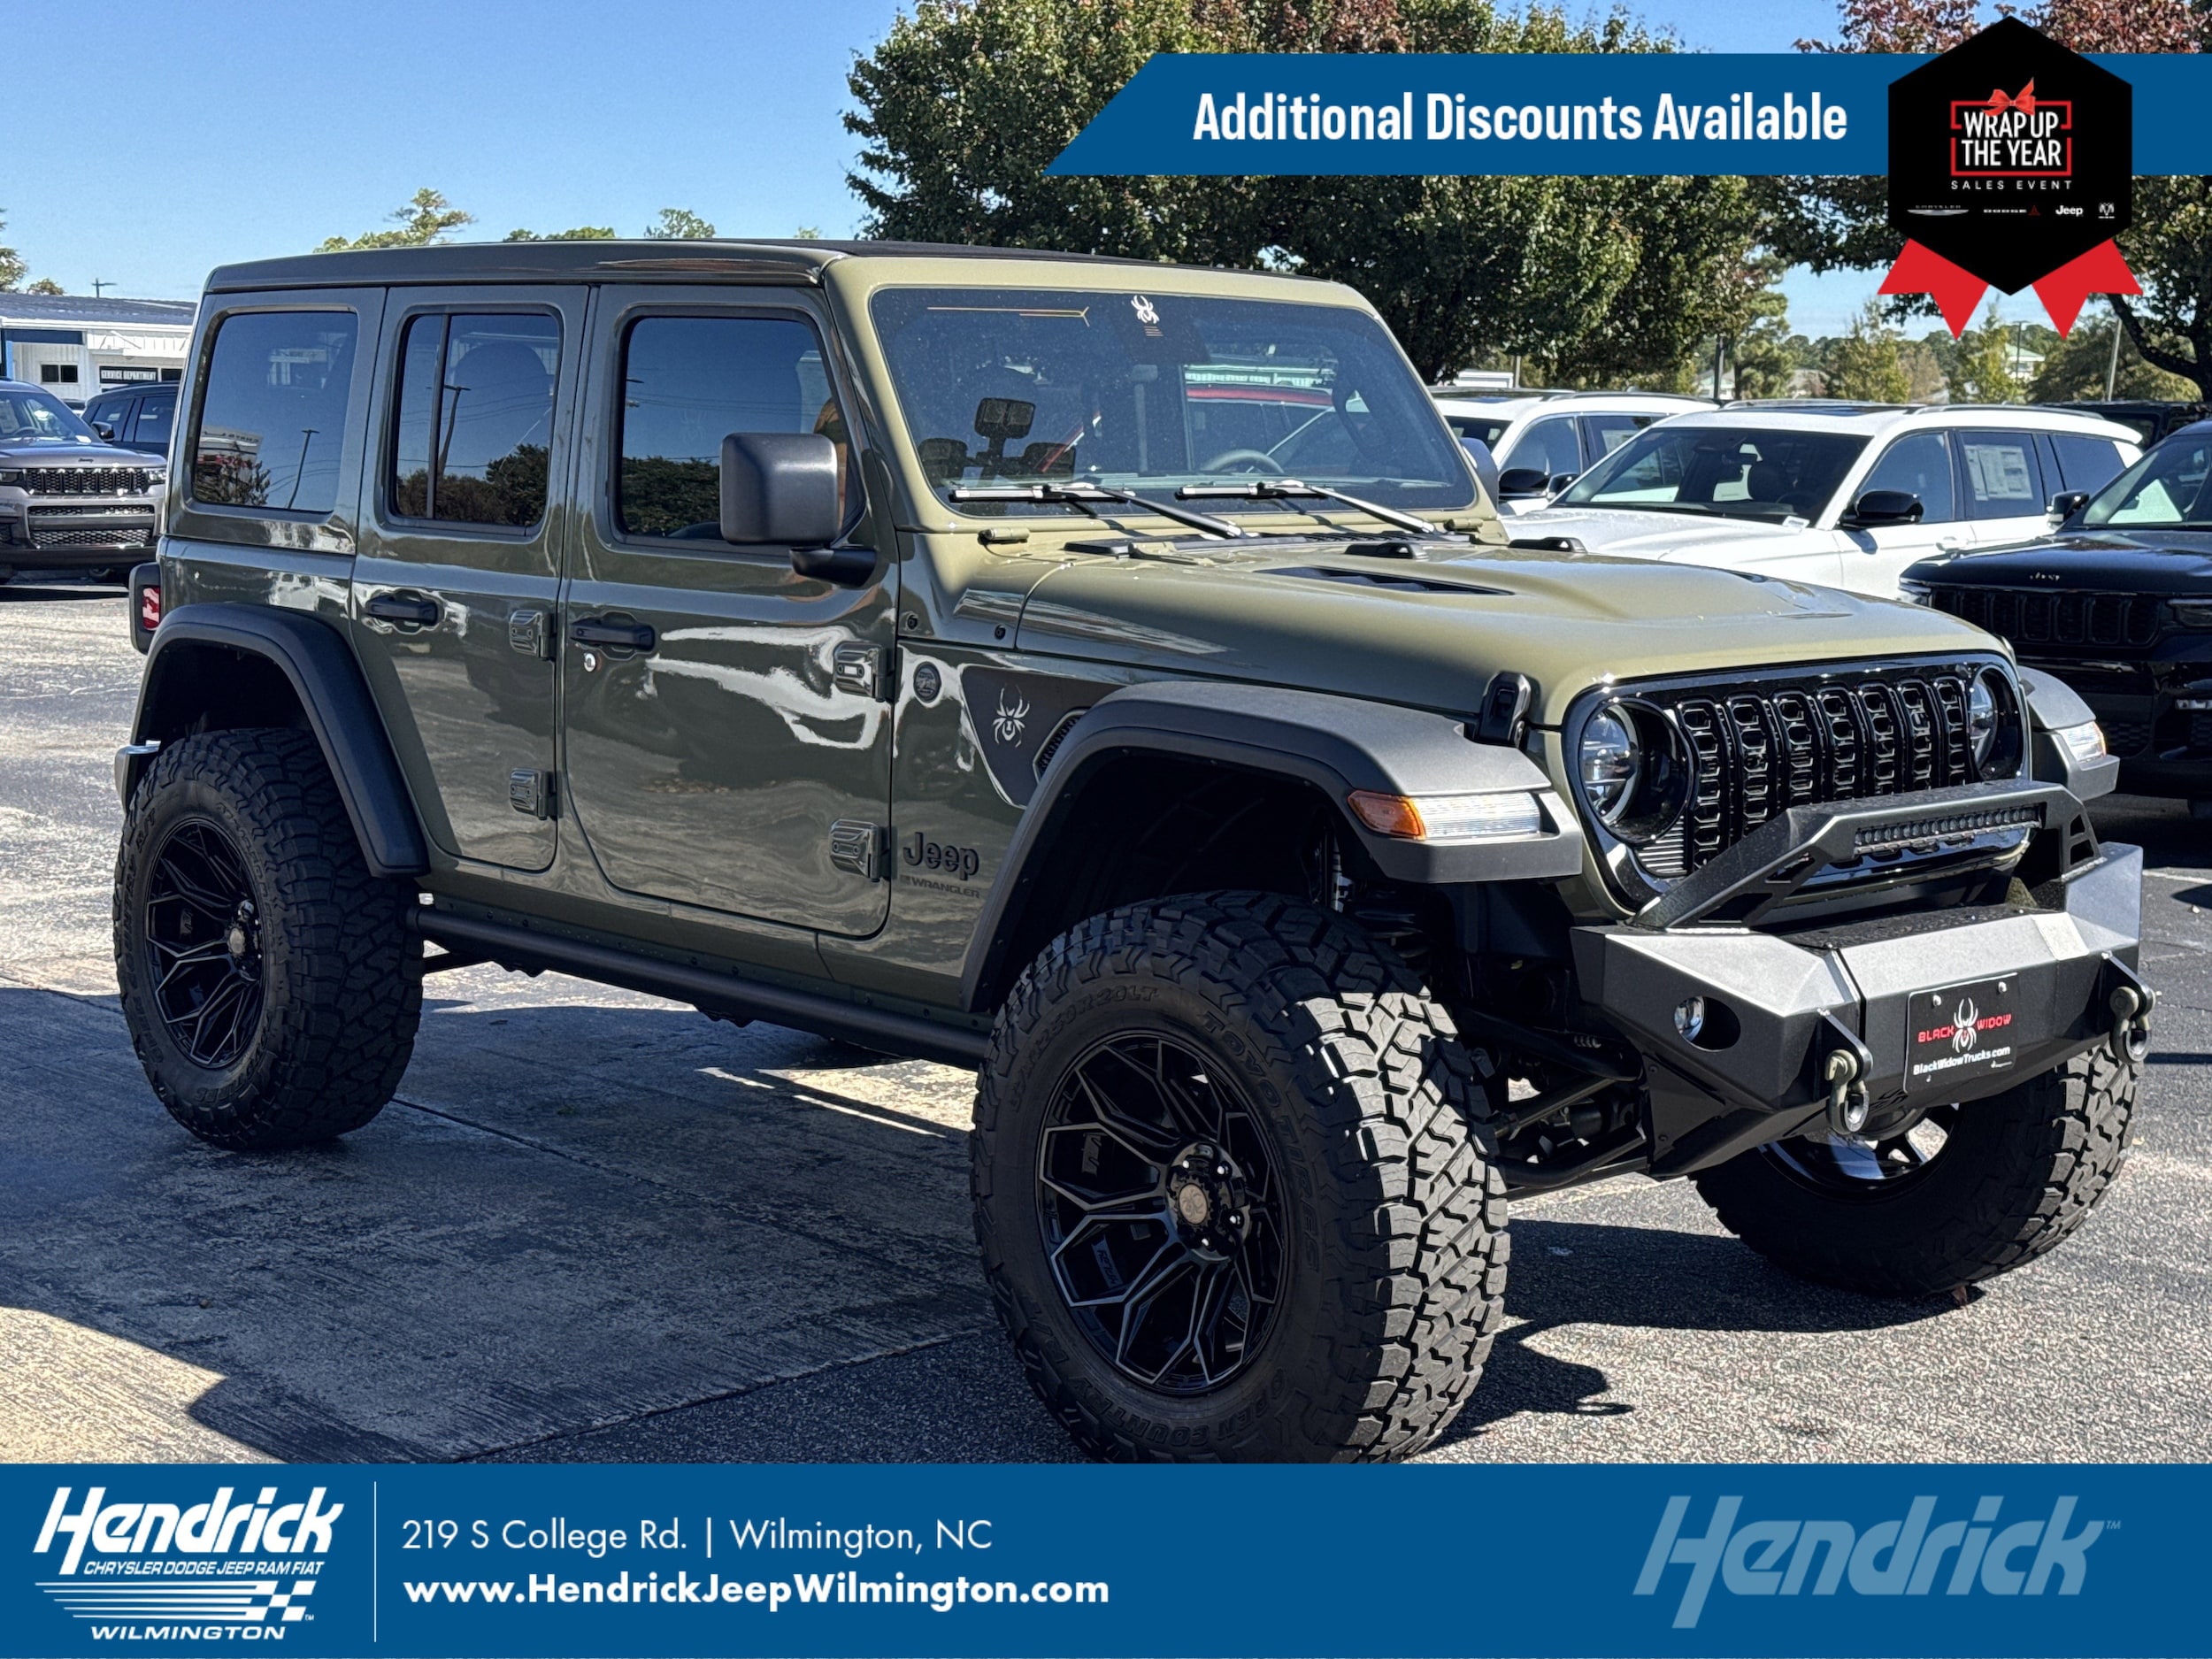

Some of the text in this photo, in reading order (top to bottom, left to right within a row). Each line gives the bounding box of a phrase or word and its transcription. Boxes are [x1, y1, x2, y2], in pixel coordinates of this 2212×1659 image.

[902, 832, 979, 881] Jeep
[911, 876, 980, 899] WRANGLER
[1916, 1014, 2012, 1043] BLACK WIDOW
[1196, 1010, 1282, 1109] TOYO
[1912, 1046, 2011, 1076] BlackWidowTrucks.com
